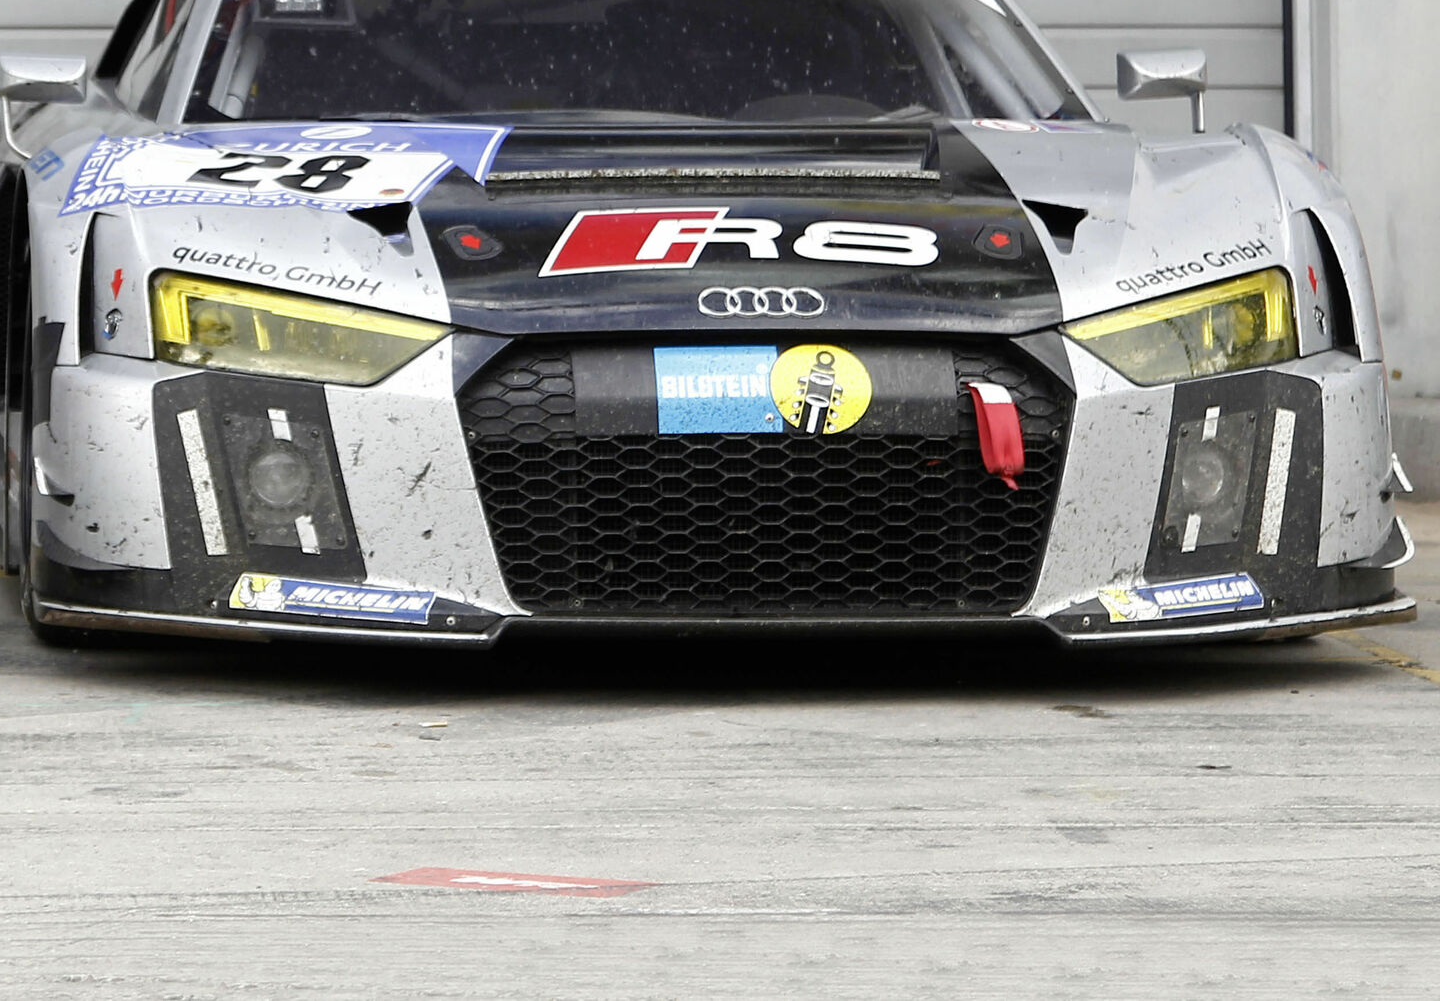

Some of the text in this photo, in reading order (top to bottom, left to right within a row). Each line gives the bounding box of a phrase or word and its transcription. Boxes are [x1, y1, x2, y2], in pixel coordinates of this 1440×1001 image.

[186, 153, 371, 194] 28
[635, 217, 940, 267] R8
[172, 245, 383, 296] quattro GmbH
[1116, 238, 1272, 295] quattro GmbH
[662, 374, 768, 399] BILSTEIN
[287, 586, 430, 611] MICHELIN
[1154, 580, 1255, 606] MICHELIN
